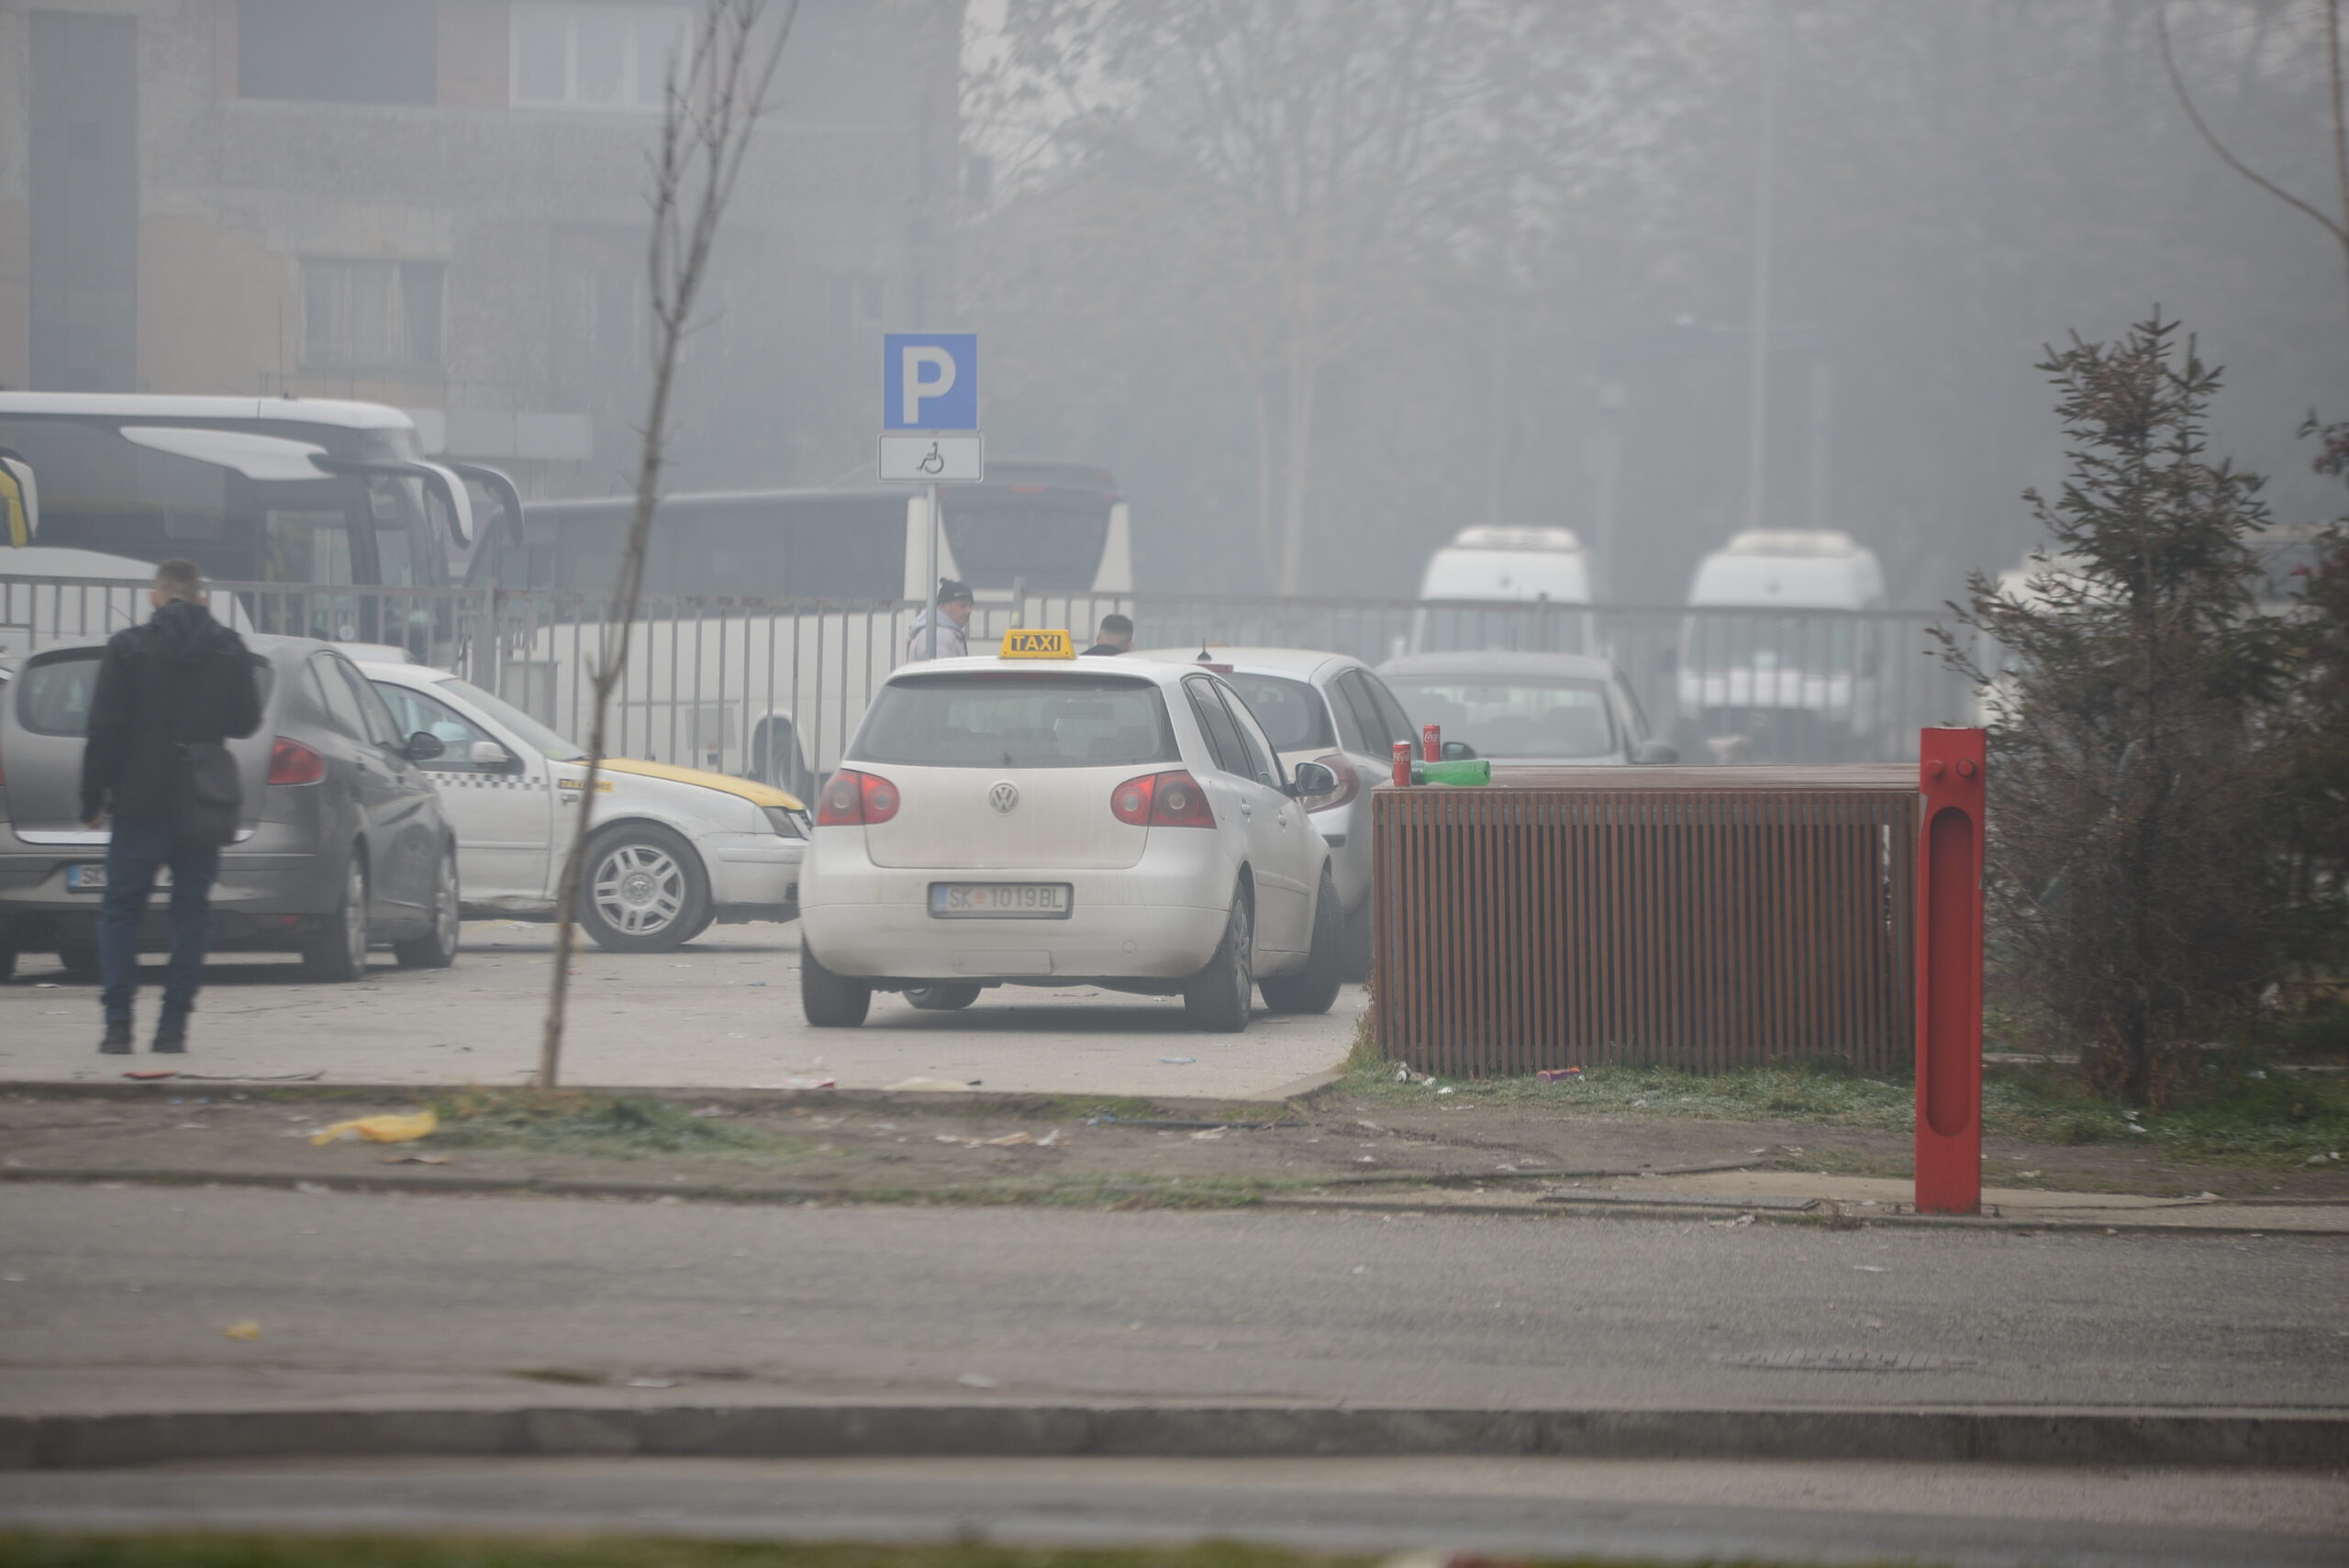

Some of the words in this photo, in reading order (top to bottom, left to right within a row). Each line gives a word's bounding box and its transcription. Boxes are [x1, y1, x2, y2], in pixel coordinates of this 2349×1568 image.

[903, 346, 956, 424] P
[1012, 635, 1060, 651] TAXI
[949, 888, 973, 908] SK
